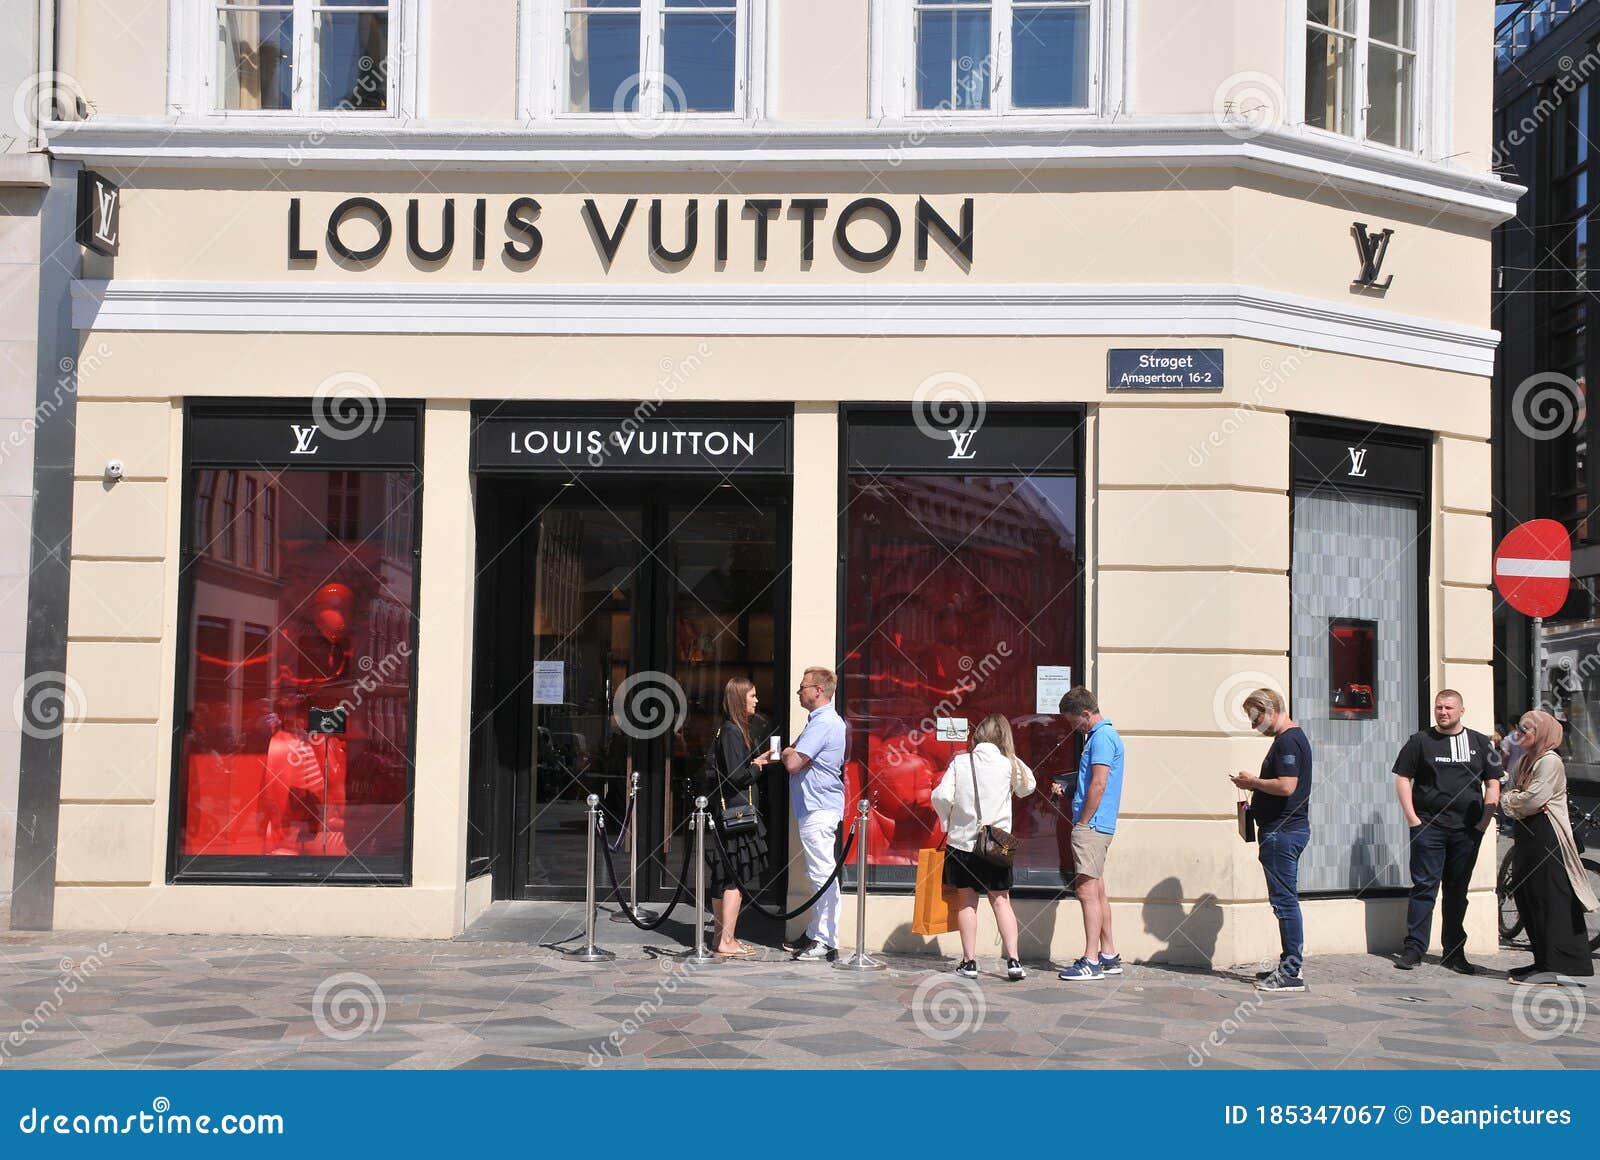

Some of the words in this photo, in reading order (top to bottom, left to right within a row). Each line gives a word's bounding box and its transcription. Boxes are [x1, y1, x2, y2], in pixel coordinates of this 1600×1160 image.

[289, 197, 544, 262] LOUIS
[583, 195, 974, 263] VUITTON
[1139, 354, 1193, 370] Strøget
[1120, 373, 1183, 385] Amagertorv
[1188, 372, 1212, 383] 16-2
[510, 430, 602, 455] LOUIS
[615, 431, 755, 456] VUITTON
